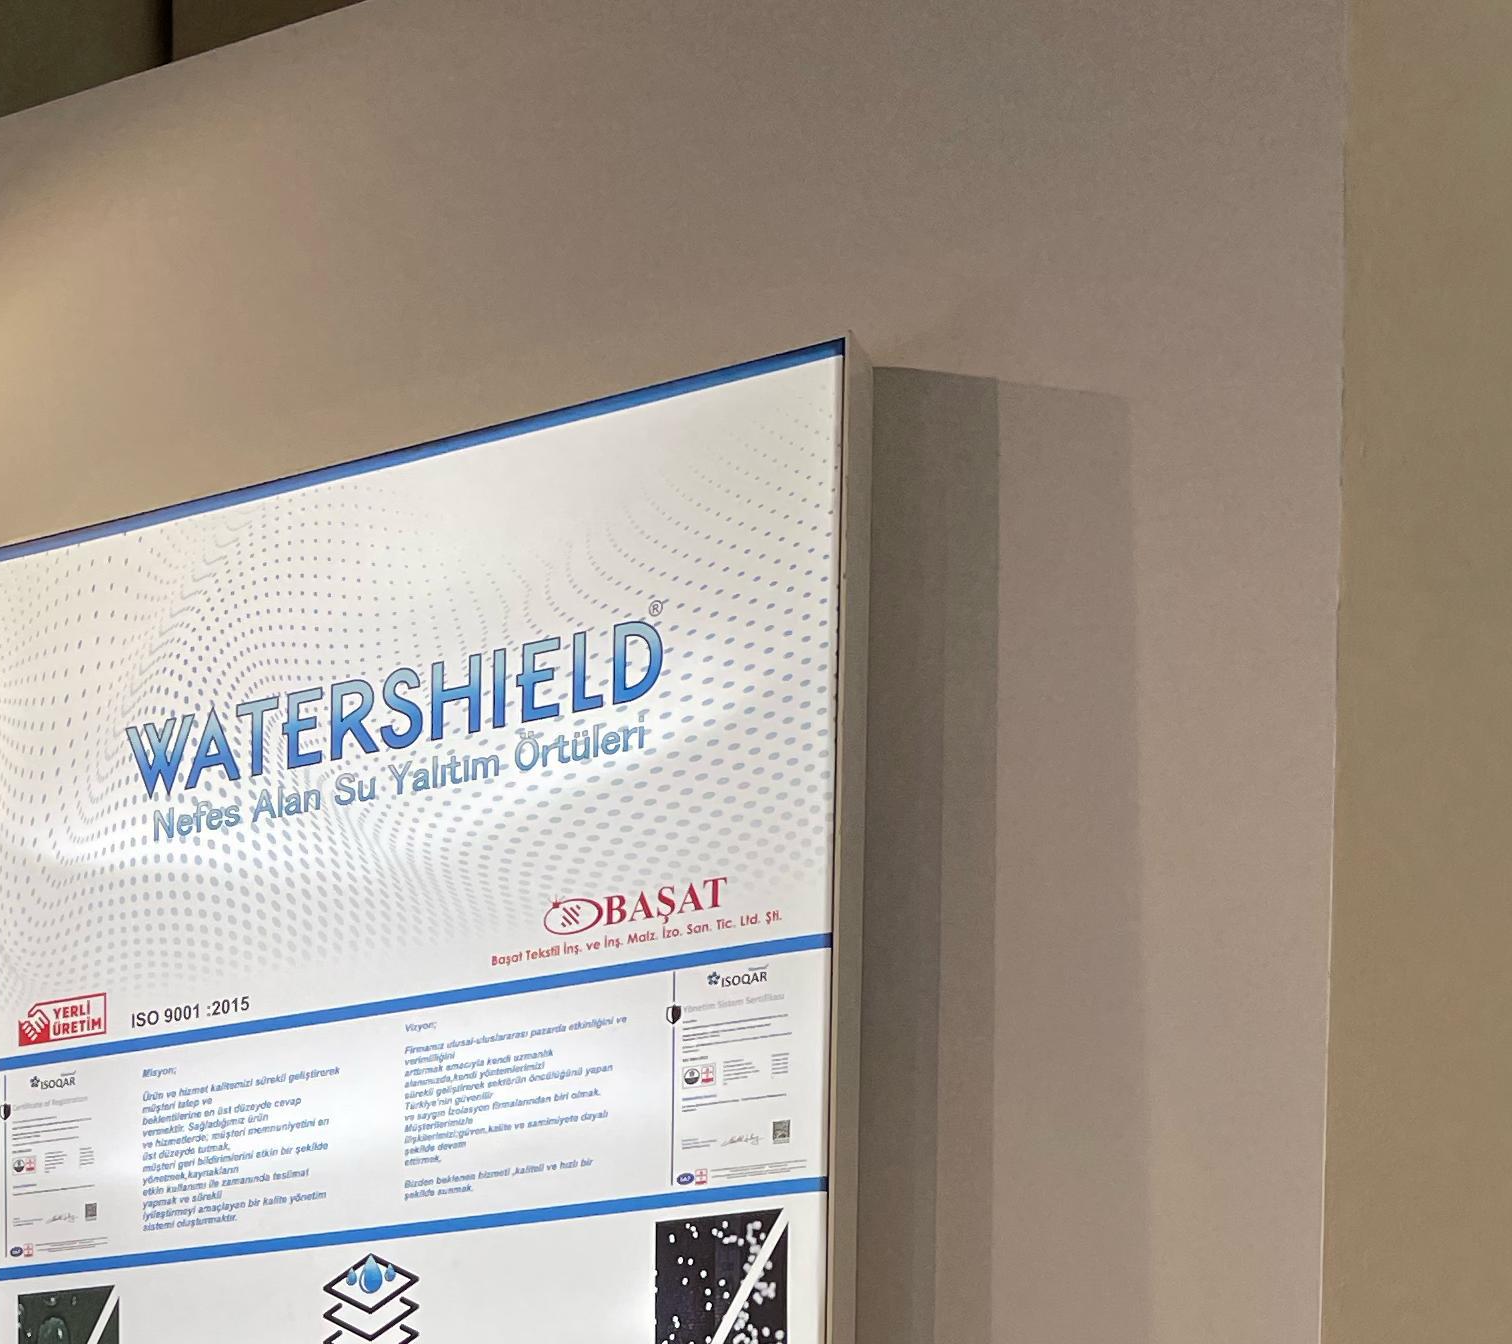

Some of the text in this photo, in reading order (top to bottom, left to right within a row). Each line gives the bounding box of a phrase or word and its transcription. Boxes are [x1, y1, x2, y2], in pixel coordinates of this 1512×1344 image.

[126, 620, 663, 800] WATERSHIELD
[153, 716, 644, 841] Nefes Alan Su Yalıtım Örtüleri
[603, 876, 727, 926] BAŞAT
[492, 910, 782, 966] Başat Tekstil İnş. ve İnş. Malz. İzo. San. Tic. Ltd. Şti.
[722, 971, 768, 987] ISOQAR
[53, 1000, 90, 1020] YERLİ
[53, 1015, 101, 1036] ÜRETİM
[131, 997, 250, 1029] ISO 9001 :2015
[41, 1077, 75, 1089] ISOQAR
